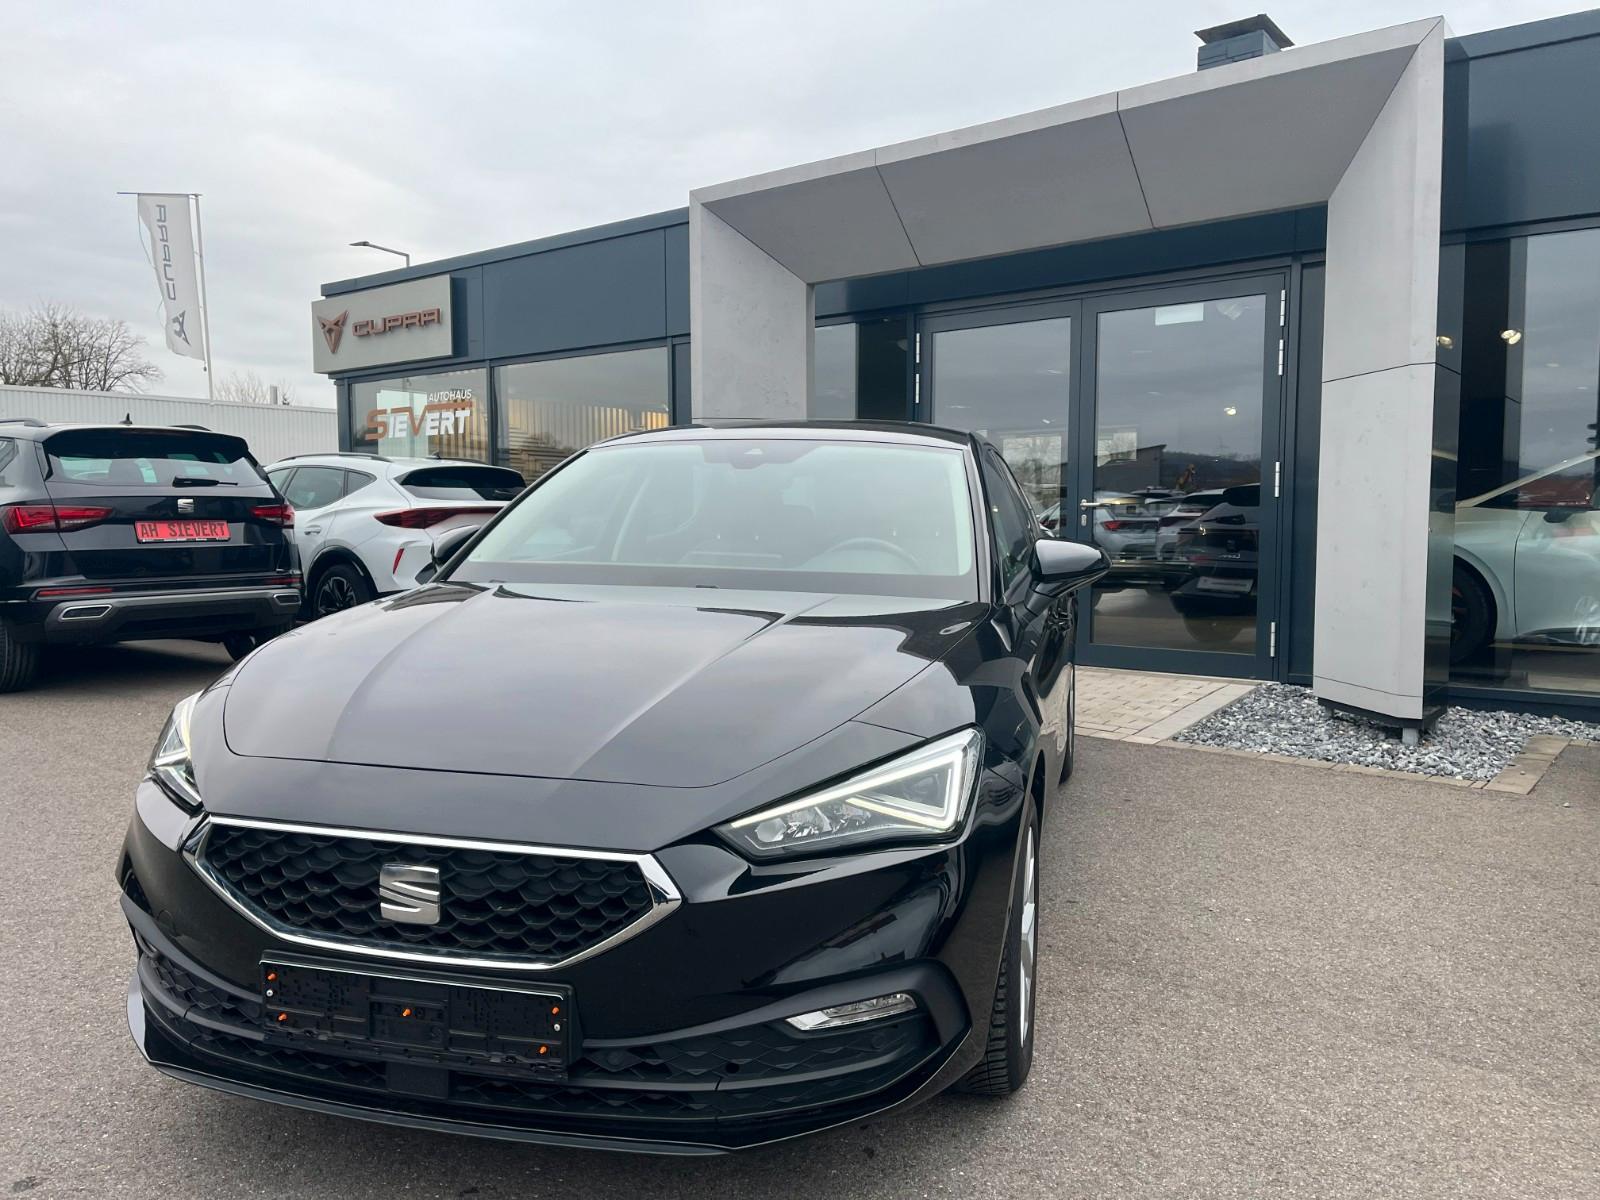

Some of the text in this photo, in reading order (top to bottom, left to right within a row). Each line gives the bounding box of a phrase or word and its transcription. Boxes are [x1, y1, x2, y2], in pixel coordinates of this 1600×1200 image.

[352, 308, 440, 336] CUPRA
[429, 389, 472, 402] AUTOHAUS
[141, 522, 226, 538] AH SIEVERT
